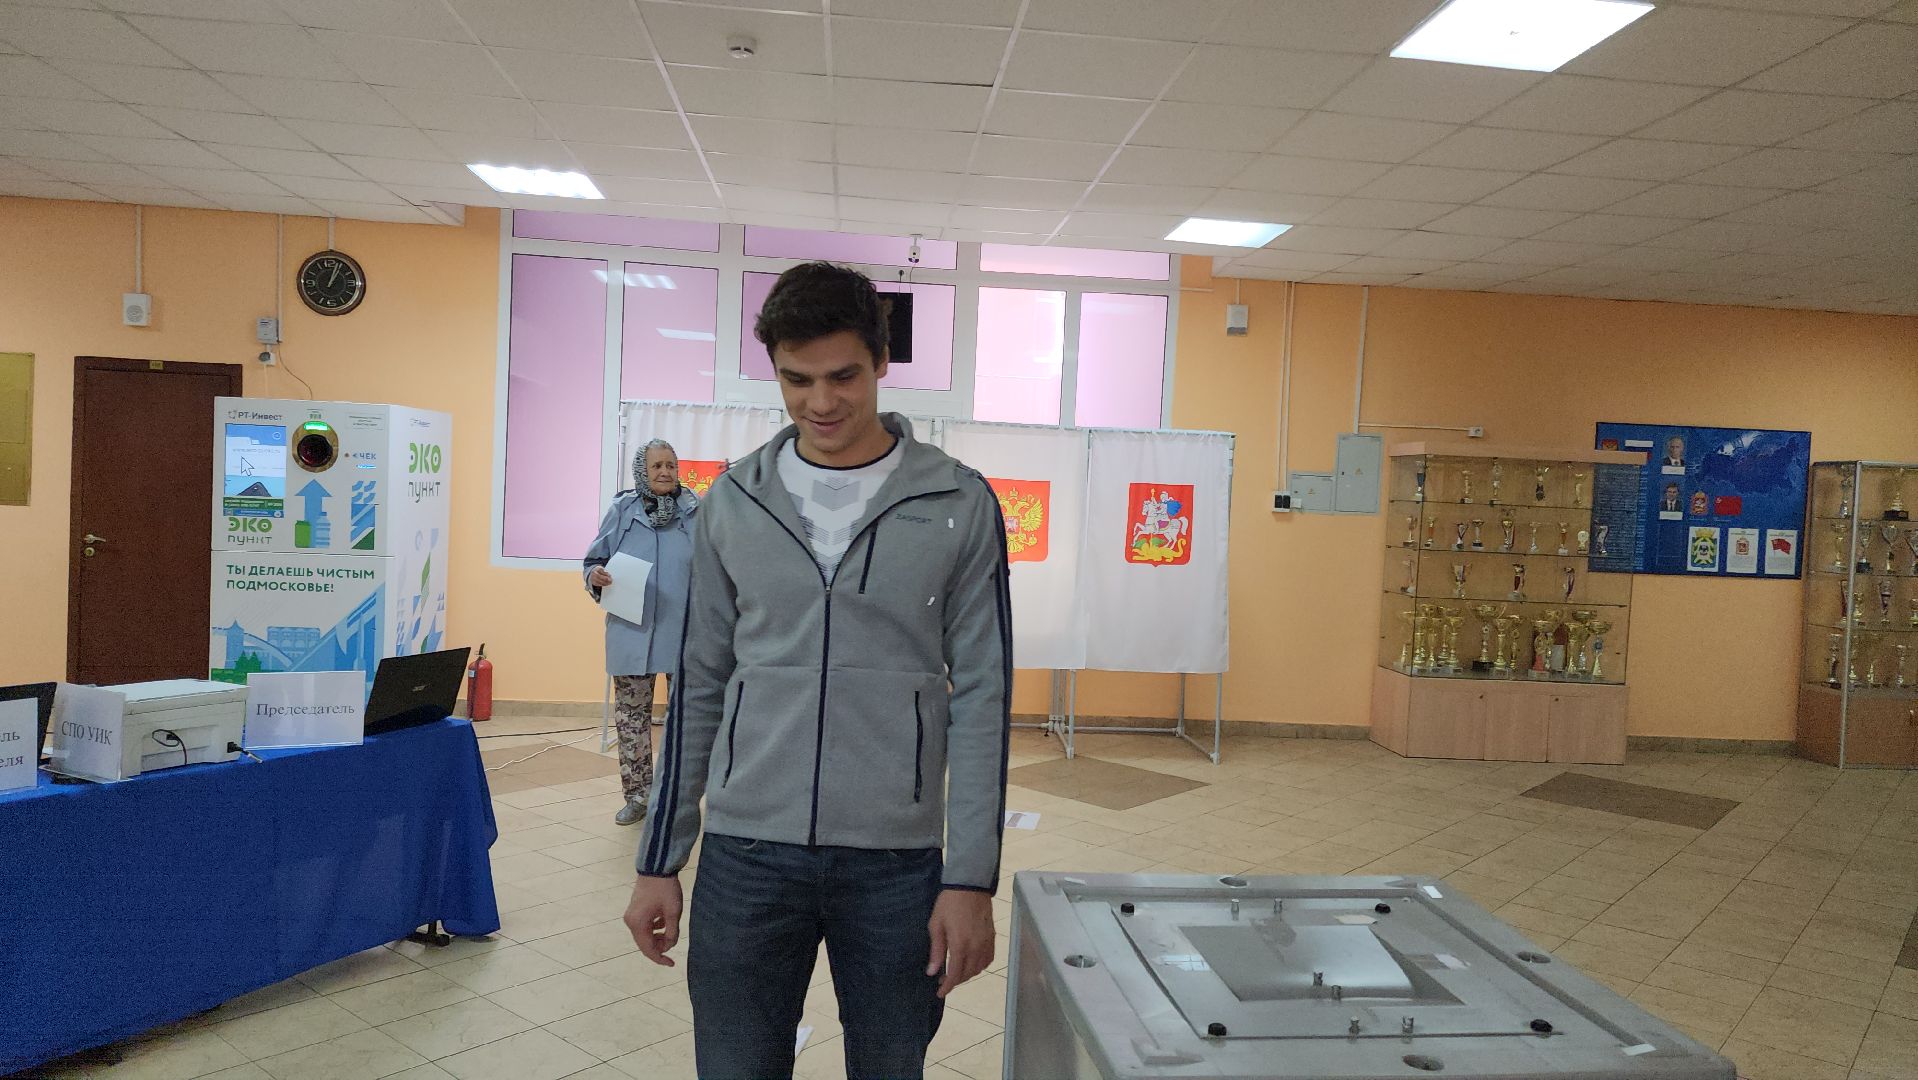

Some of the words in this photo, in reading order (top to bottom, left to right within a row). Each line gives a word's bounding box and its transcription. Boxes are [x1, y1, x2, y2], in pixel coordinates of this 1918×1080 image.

[324, 259, 337, 268] 12
[238, 411, 283, 421] РТ-Инвест
[359, 452, 377, 460] ЧЕК
[226, 565, 246, 575] ТЫ
[248, 565, 313, 577] ДЕЛАЕШЬ
[317, 568, 375, 579] ЧИСТЫМ
[226, 580, 334, 593] ПОДМОСКОВЬЕ!
[256, 703, 355, 718] Председатель
[61, 720, 85, 740] СПО
[87, 725, 113, 746] УИК
